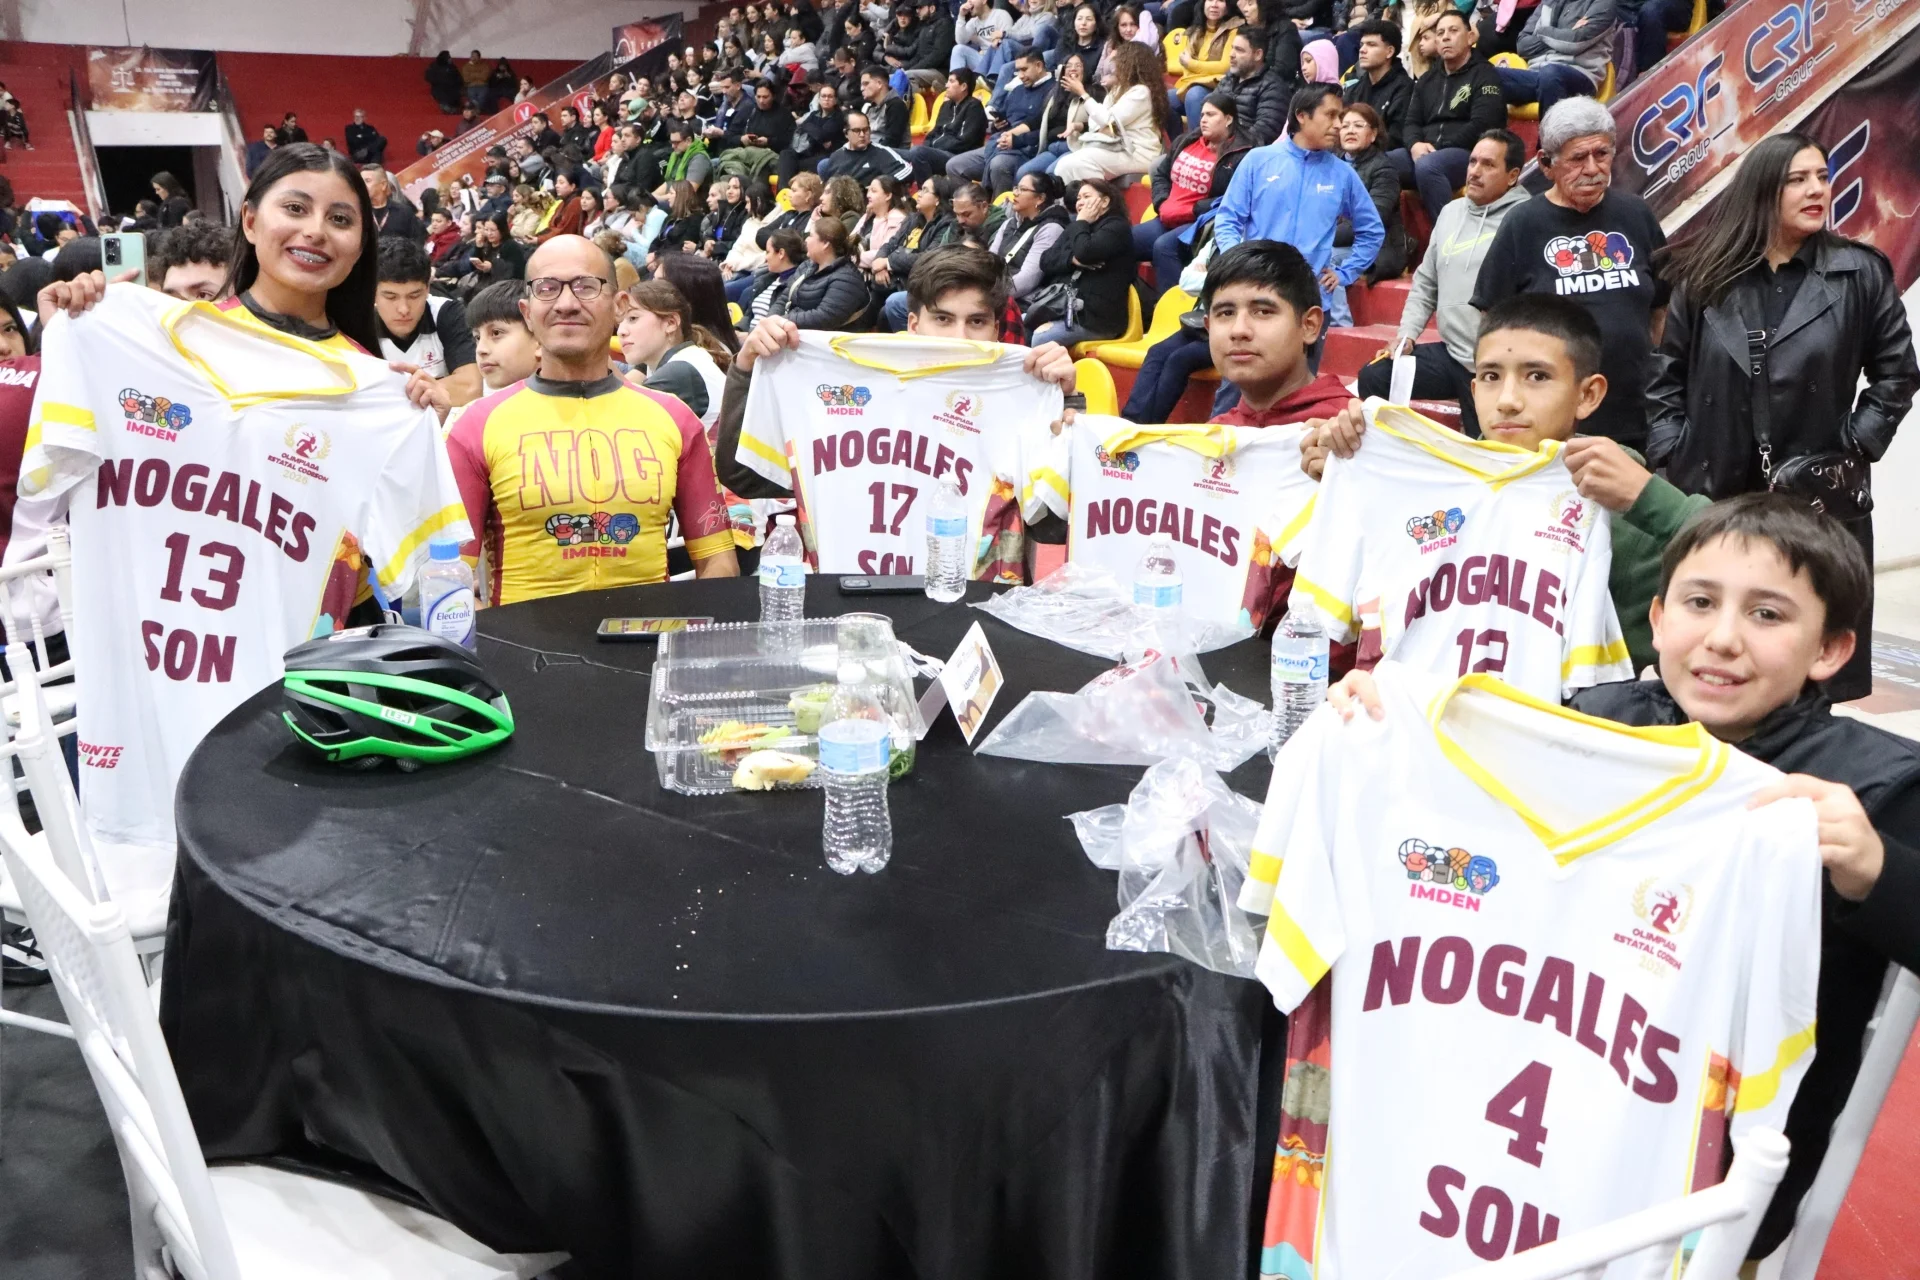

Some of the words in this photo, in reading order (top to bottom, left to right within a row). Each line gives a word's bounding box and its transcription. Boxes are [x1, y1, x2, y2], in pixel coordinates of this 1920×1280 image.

[1774, 57, 1815, 100] GROUP
[1667, 138, 1711, 183] GROUP
[1555, 269, 1640, 295] IMDEN
[126, 420, 178, 443] IMDEN
[827, 407, 864, 416] IMDEN
[267, 455, 296, 470] ESTATAL
[281, 452, 320, 471] OLIMPIADA
[519, 428, 663, 511] NOG
[813, 427, 974, 497] NOGALES
[1102, 467, 1133, 481] IMDEN
[96, 458, 317, 563] NOGALES
[868, 481, 919, 537] 17
[562, 545, 627, 560] IMDEN
[1086, 497, 1241, 567] NOGALES
[1420, 535, 1457, 555] IMDEN
[160, 531, 246, 612] 13
[141, 620, 237, 683] SON
[1409, 883, 1481, 912] IMDEN
[1613, 933, 1654, 955] ESTATAL
[1362, 936, 1681, 1104] NOGALES
[1484, 1060, 1553, 1168] 4
[1419, 1164, 1560, 1261] SON
